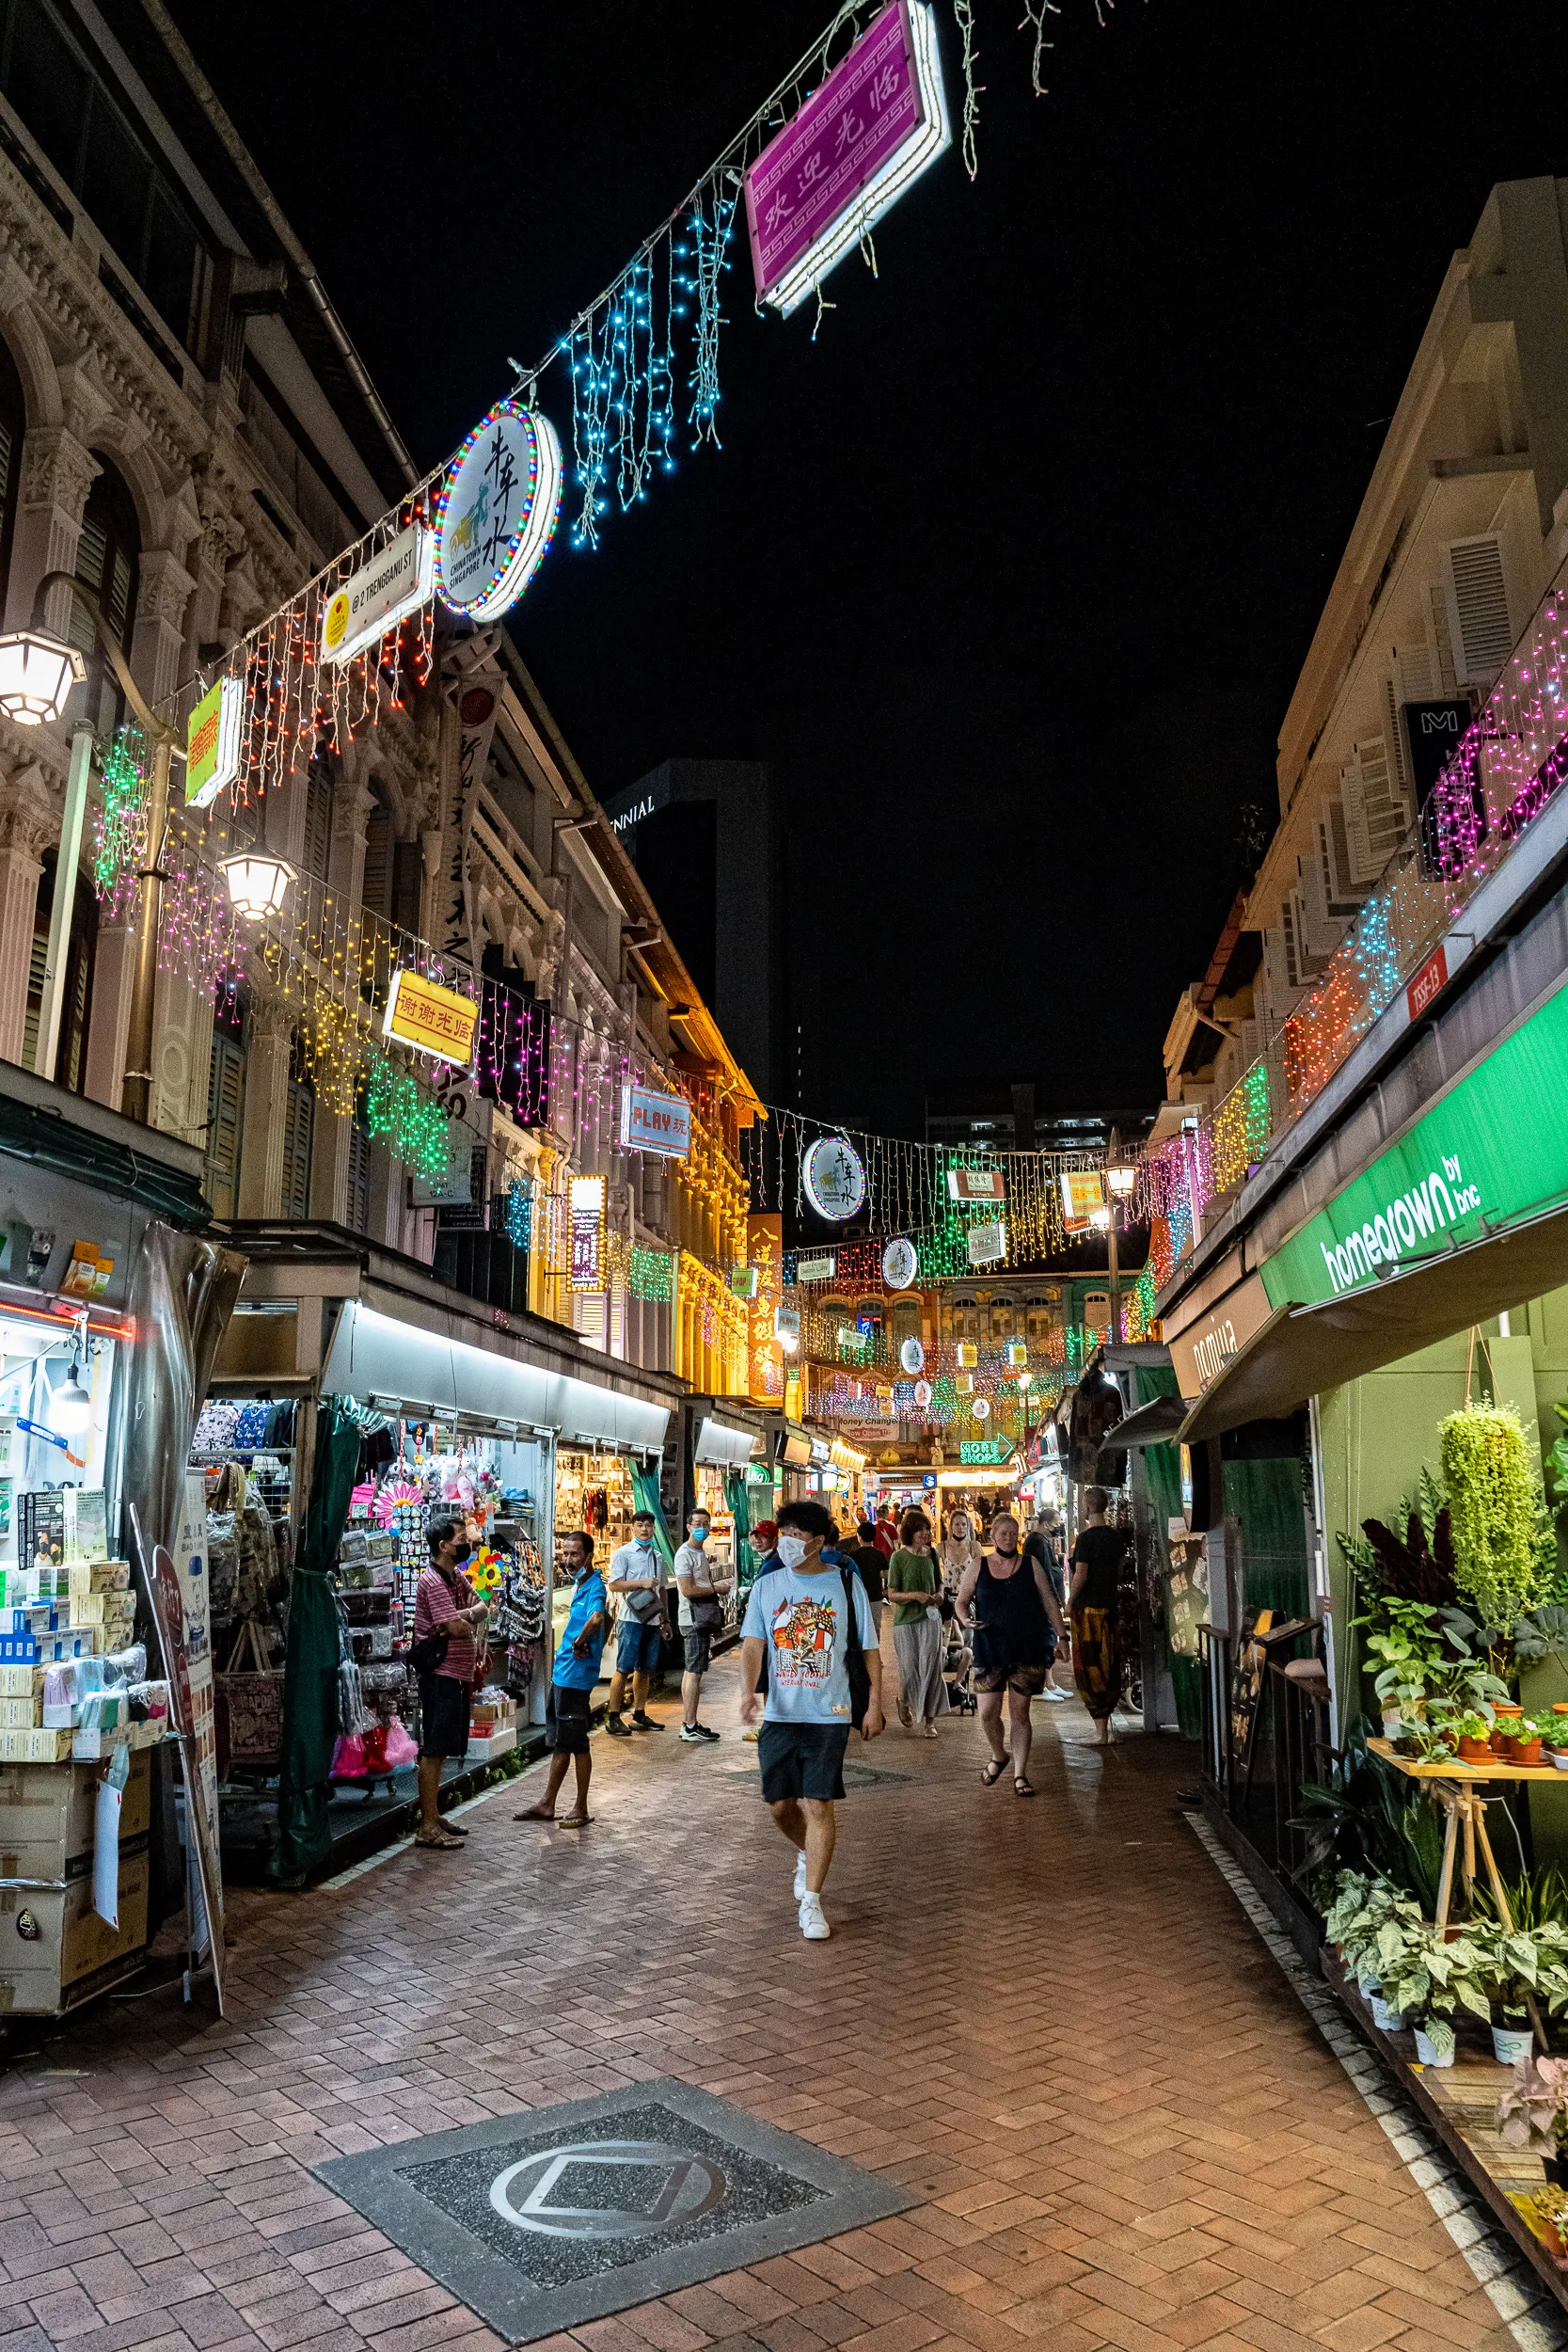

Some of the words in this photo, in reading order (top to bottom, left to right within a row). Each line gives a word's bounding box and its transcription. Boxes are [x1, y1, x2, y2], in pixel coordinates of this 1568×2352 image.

[764, 63, 900, 236] 欢迎光临
[449, 560, 480, 591] SINGAPORE
[450, 545, 482, 577] CHINATOWN
[352, 595, 360, 614] @
[359, 592, 366, 608] 2
[365, 567, 403, 601] TRENGGANU
[403, 548, 414, 571] ST
[610, 795, 655, 834] NNIAL
[1412, 963, 1440, 1012] TSSF-13
[399, 993, 472, 1041] 谢谢光临
[632, 1105, 672, 1132] PLAY
[673, 1118, 688, 1136] 玩
[1441, 1153, 1463, 1183] by
[1452, 1184, 1481, 1216] bnc
[1320, 1171, 1457, 1294] homegrown
[862, 1429, 880, 1438] Open
[959, 1443, 999, 1454] MORE
[959, 1453, 999, 1465] SHOPS
[780, 1679, 820, 1689] INTERNATIONAL
